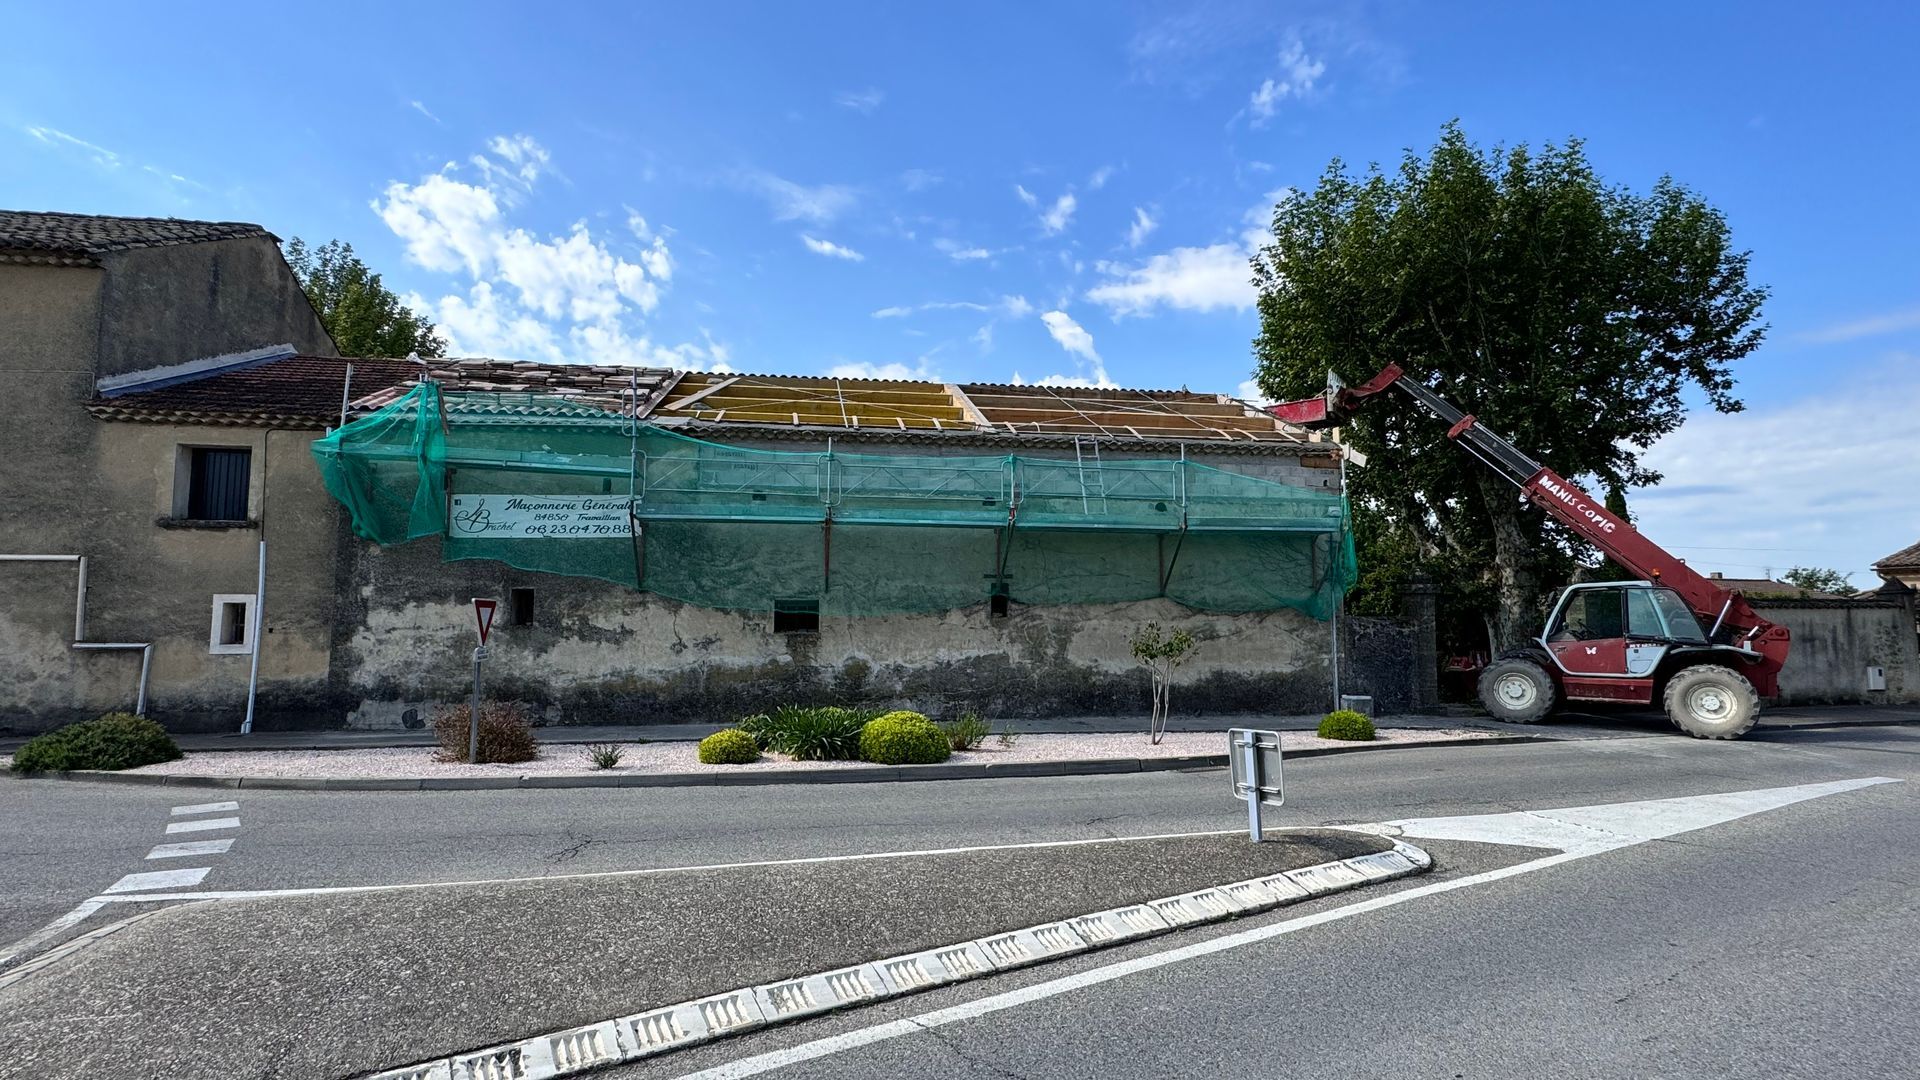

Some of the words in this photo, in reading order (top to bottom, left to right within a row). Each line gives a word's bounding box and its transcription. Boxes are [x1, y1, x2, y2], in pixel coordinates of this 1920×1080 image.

[504, 498, 577, 512] Maçonnerie
[534, 513, 569, 521] 84850
[576, 513, 621, 521] Travaillan
